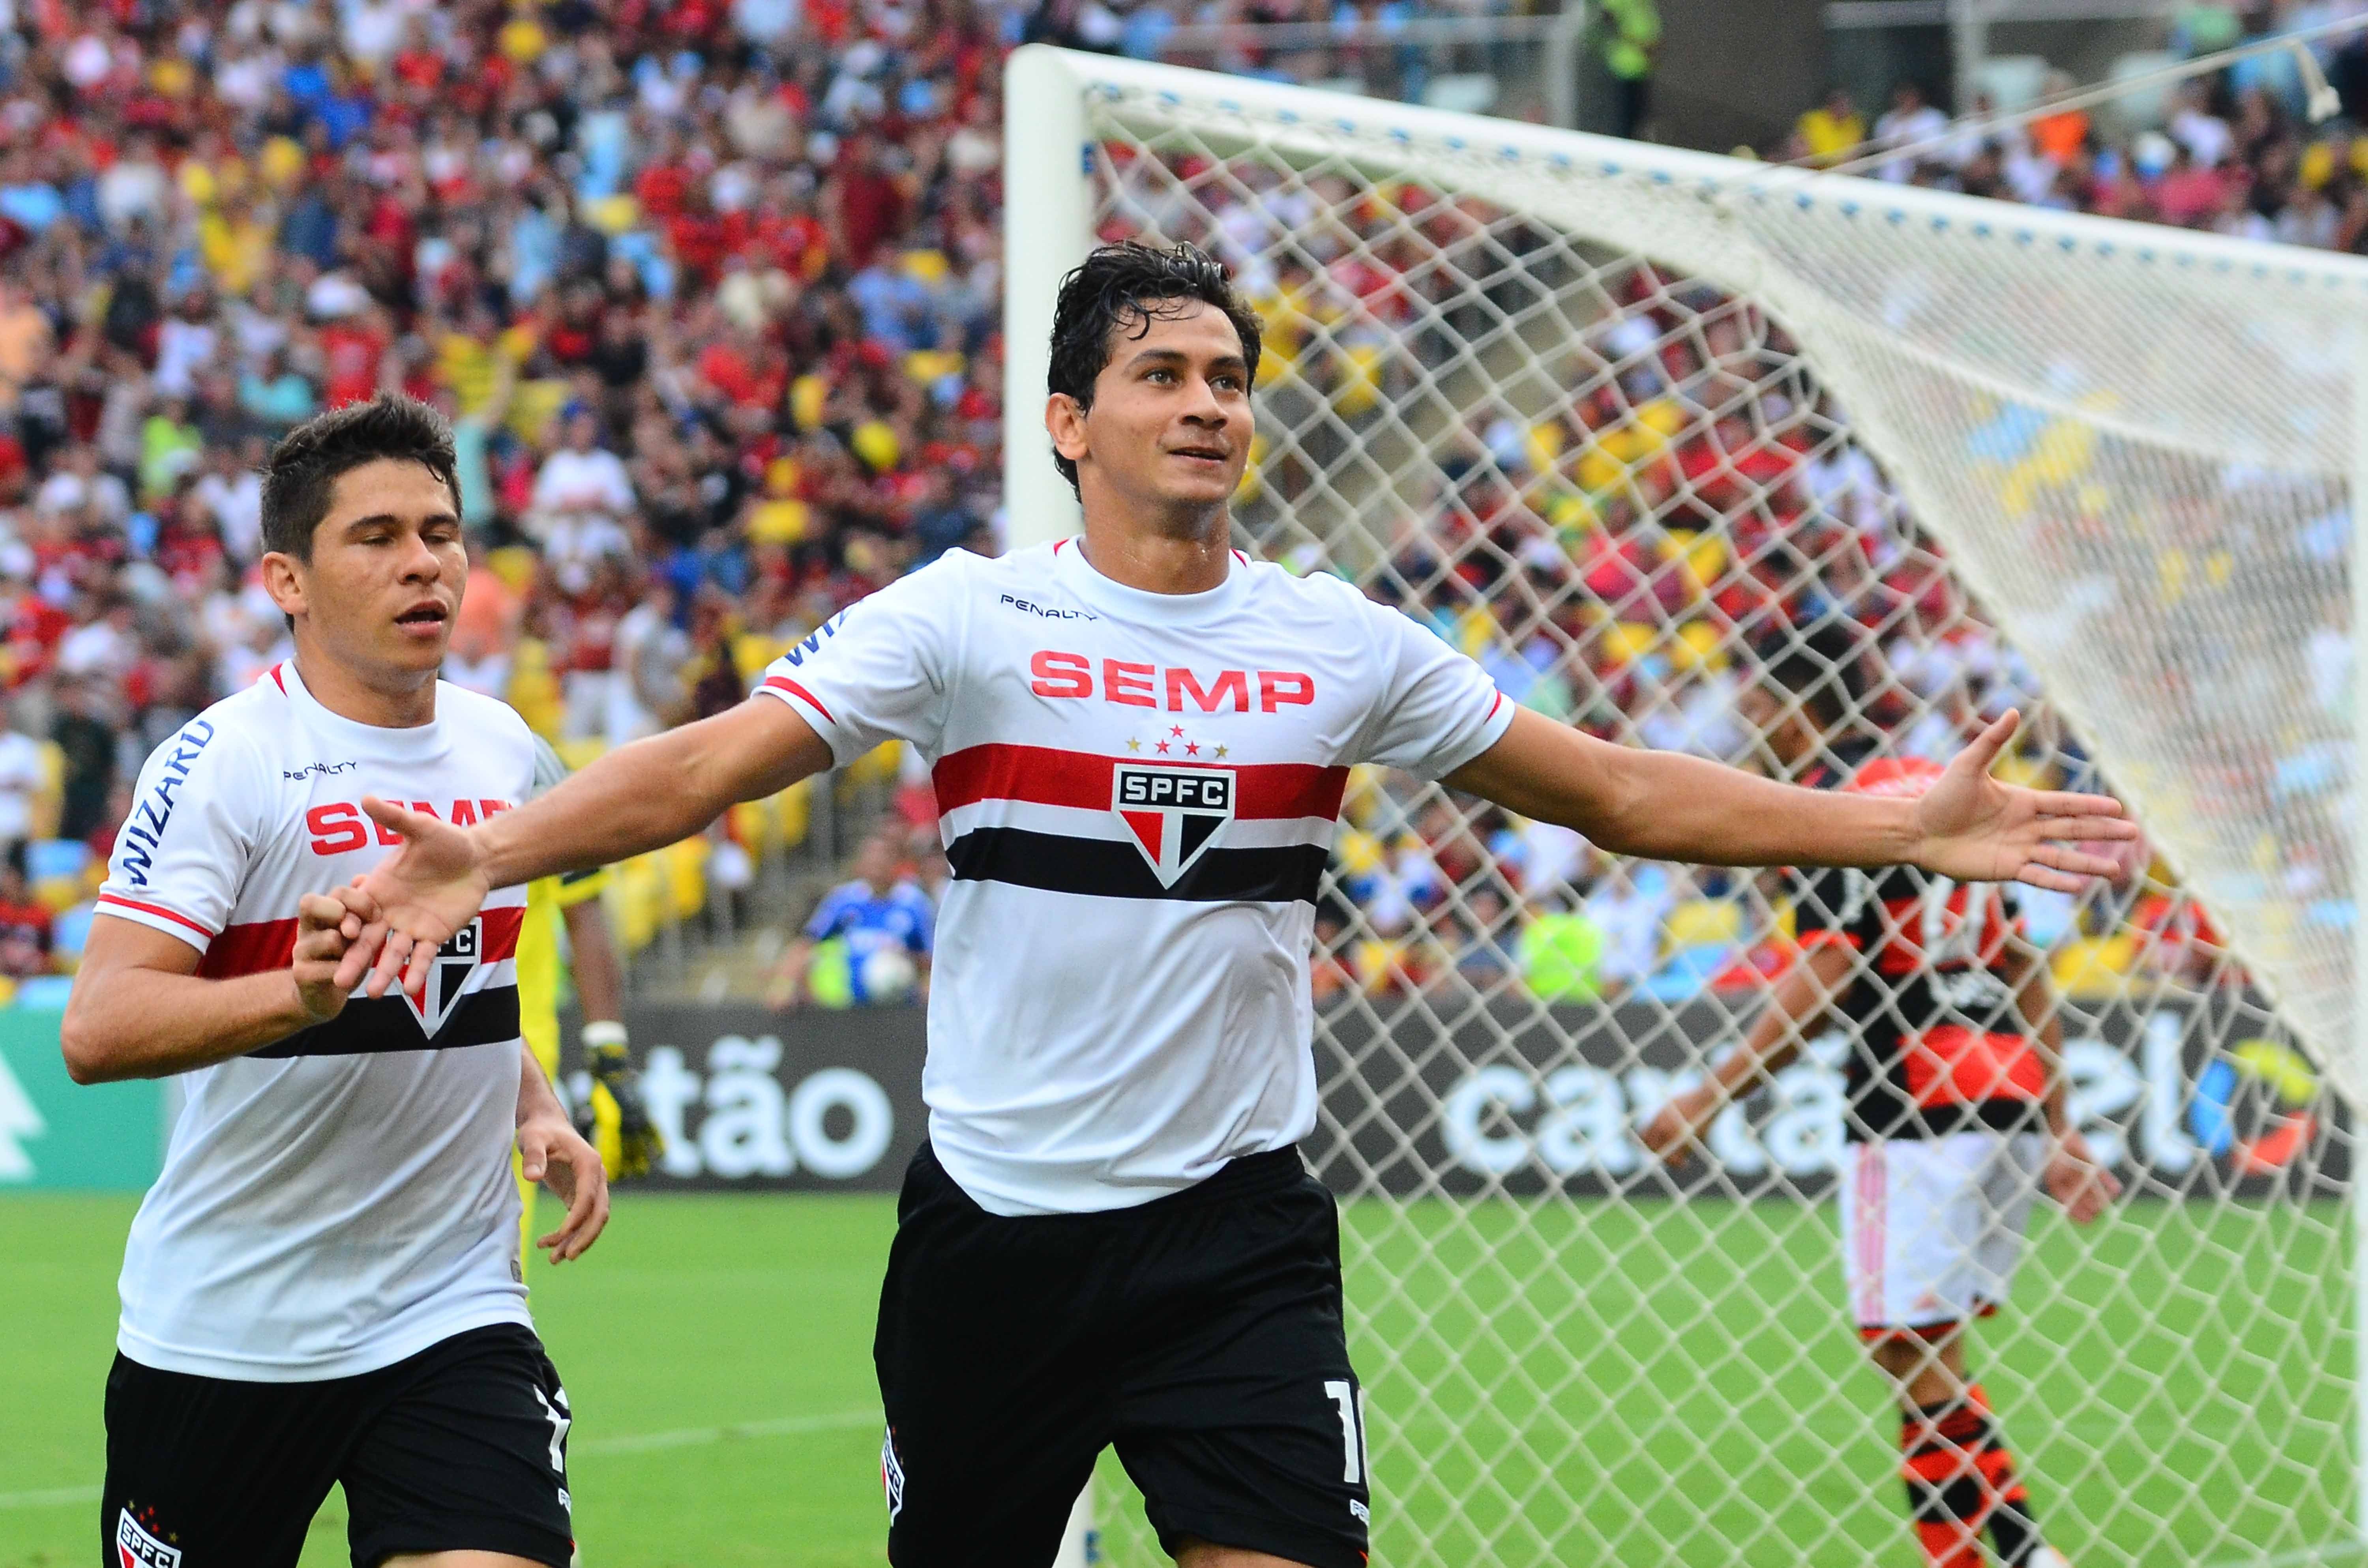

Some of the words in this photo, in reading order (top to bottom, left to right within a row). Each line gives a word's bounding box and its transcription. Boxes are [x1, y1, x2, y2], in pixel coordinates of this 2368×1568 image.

[1000, 594, 1097, 621] PENALTY
[1030, 650, 1315, 713] SEMP
[283, 761, 357, 782] PENALTY
[1125, 776, 1223, 805] SPFC
[123, 720, 214, 887] WIZARD
[122, 1521, 170, 1568] SPFC
